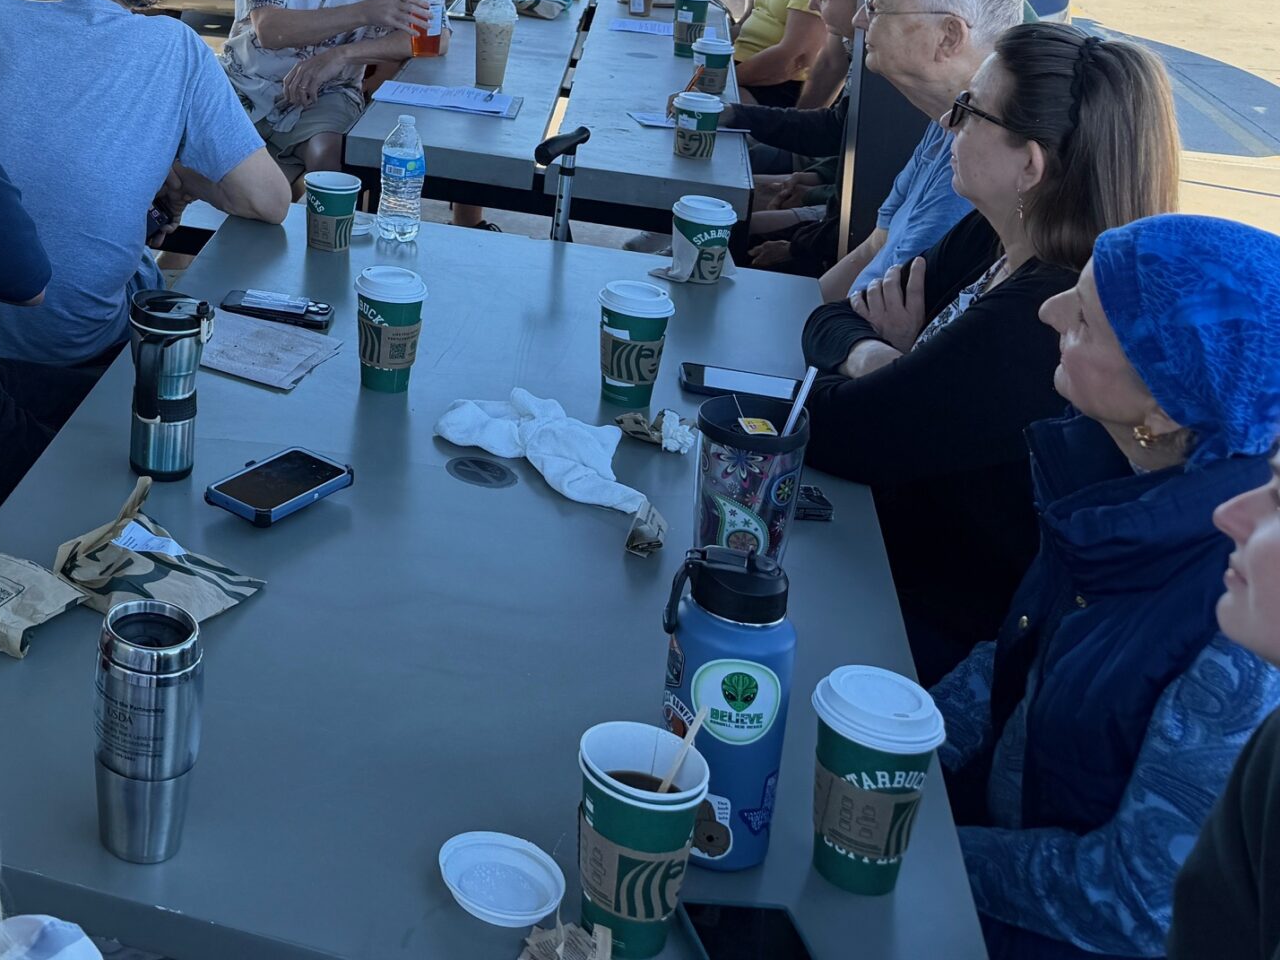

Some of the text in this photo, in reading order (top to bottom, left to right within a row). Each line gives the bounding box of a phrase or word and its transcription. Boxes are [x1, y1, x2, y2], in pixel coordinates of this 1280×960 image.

[107, 707, 133, 725] USDA
[710, 707, 763, 725] BELIEVE
[841, 771, 926, 790] TARBUC
